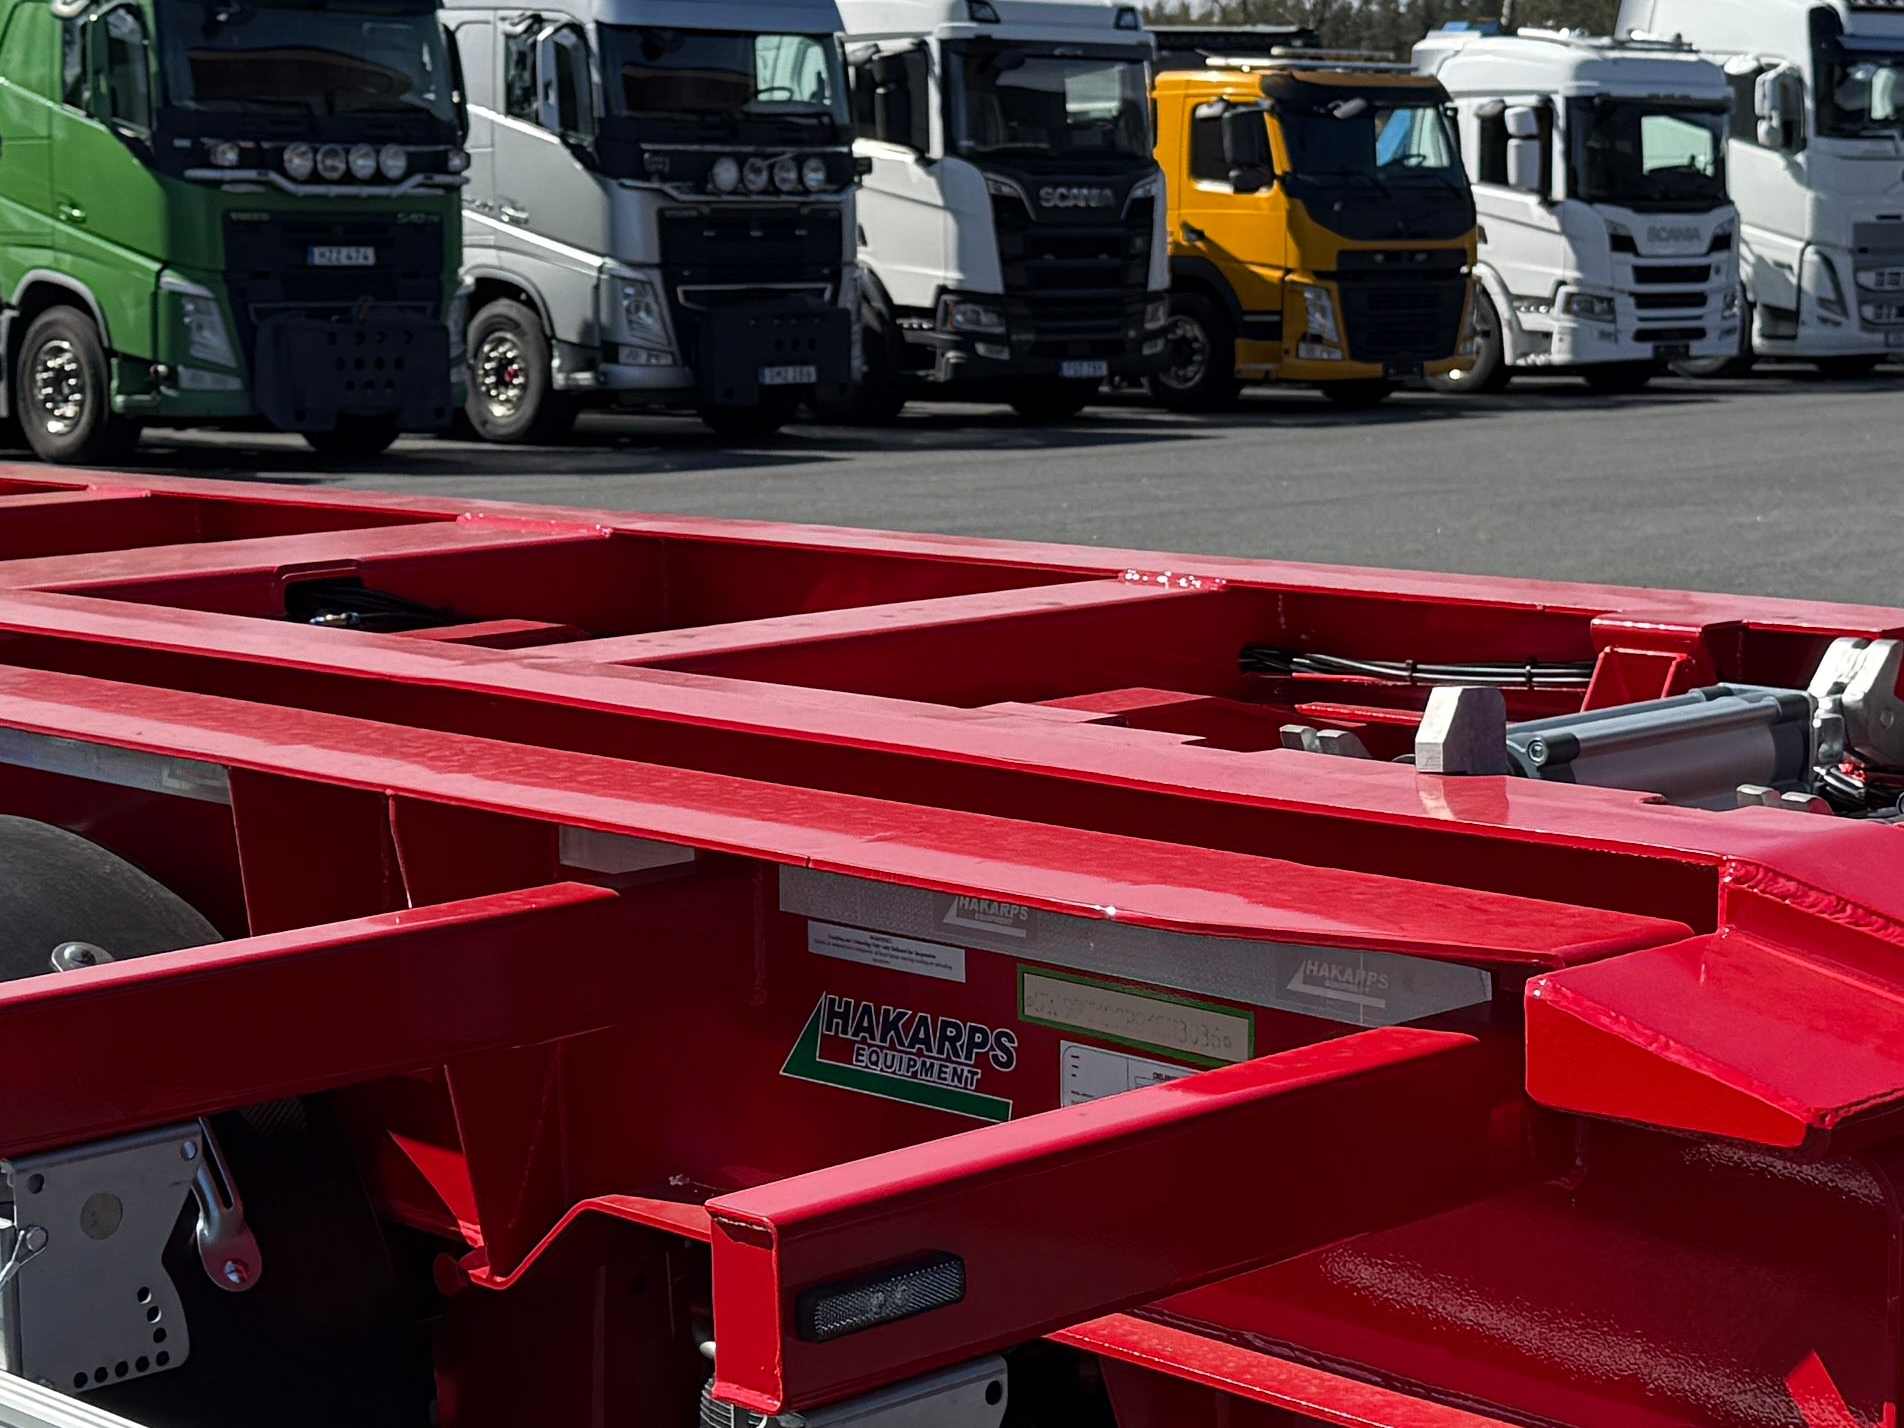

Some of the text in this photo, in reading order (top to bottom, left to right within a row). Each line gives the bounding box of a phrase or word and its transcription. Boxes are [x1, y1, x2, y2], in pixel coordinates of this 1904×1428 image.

[958, 896, 1029, 921] HAKARPS
[1306, 959, 1389, 989] HAKARPS
[823, 994, 1018, 1072] HAKARPS
[853, 1044, 981, 1090] EQUIPMENT
